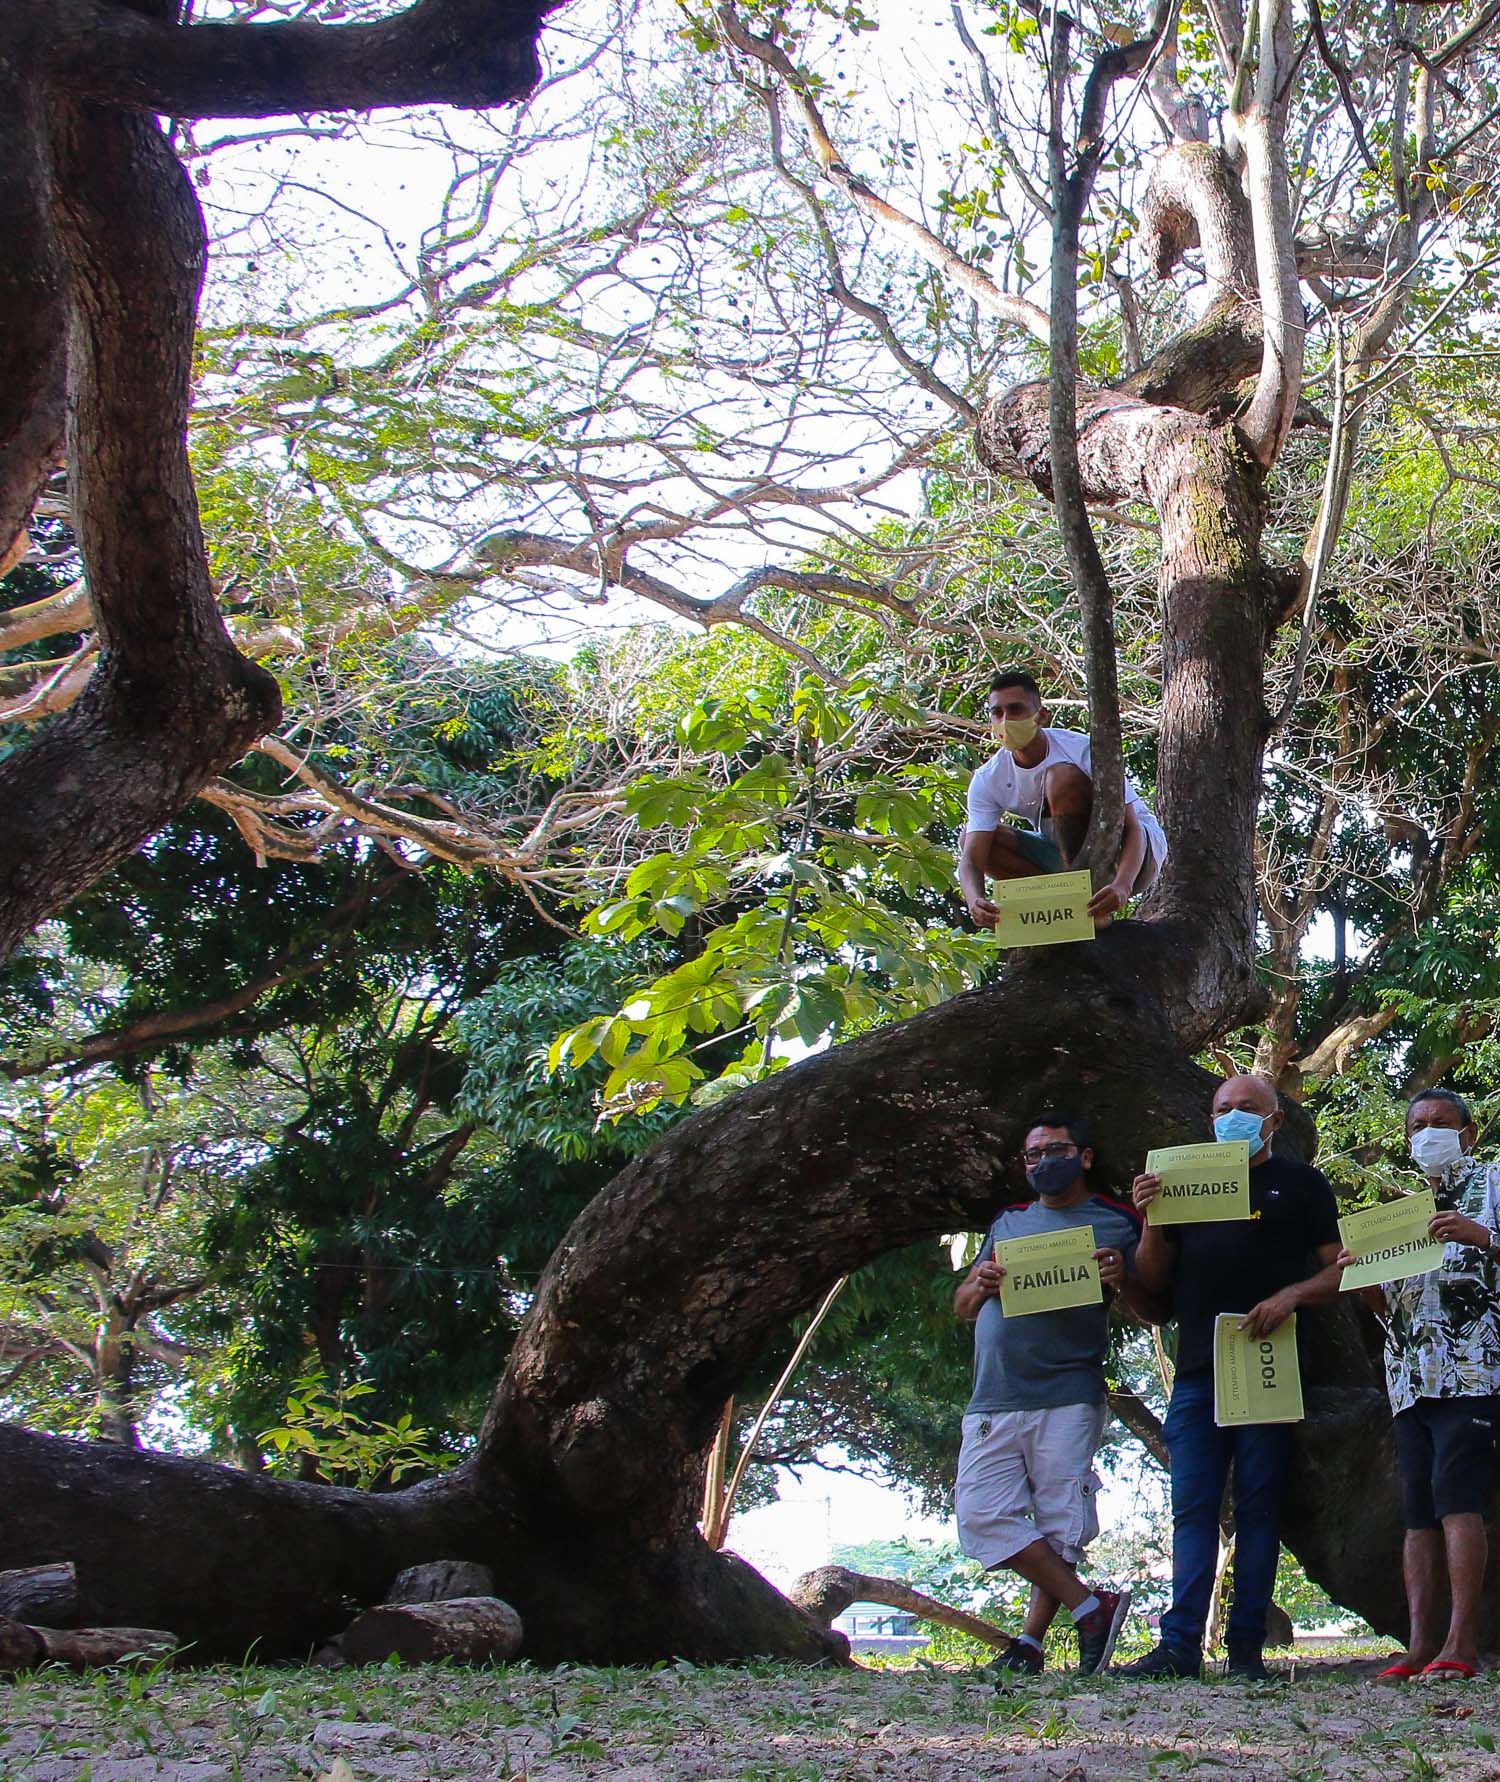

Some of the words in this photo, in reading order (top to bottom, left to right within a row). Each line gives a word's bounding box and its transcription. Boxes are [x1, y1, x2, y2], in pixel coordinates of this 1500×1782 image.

[1019, 907, 1074, 925] VIAJAR
[1162, 1181, 1239, 1198] AMIZADES
[1355, 1235, 1438, 1268] AUTOESTIMA
[1012, 1264, 1090, 1291] FAMÍLIA
[1260, 1341, 1277, 1389] FOCO
